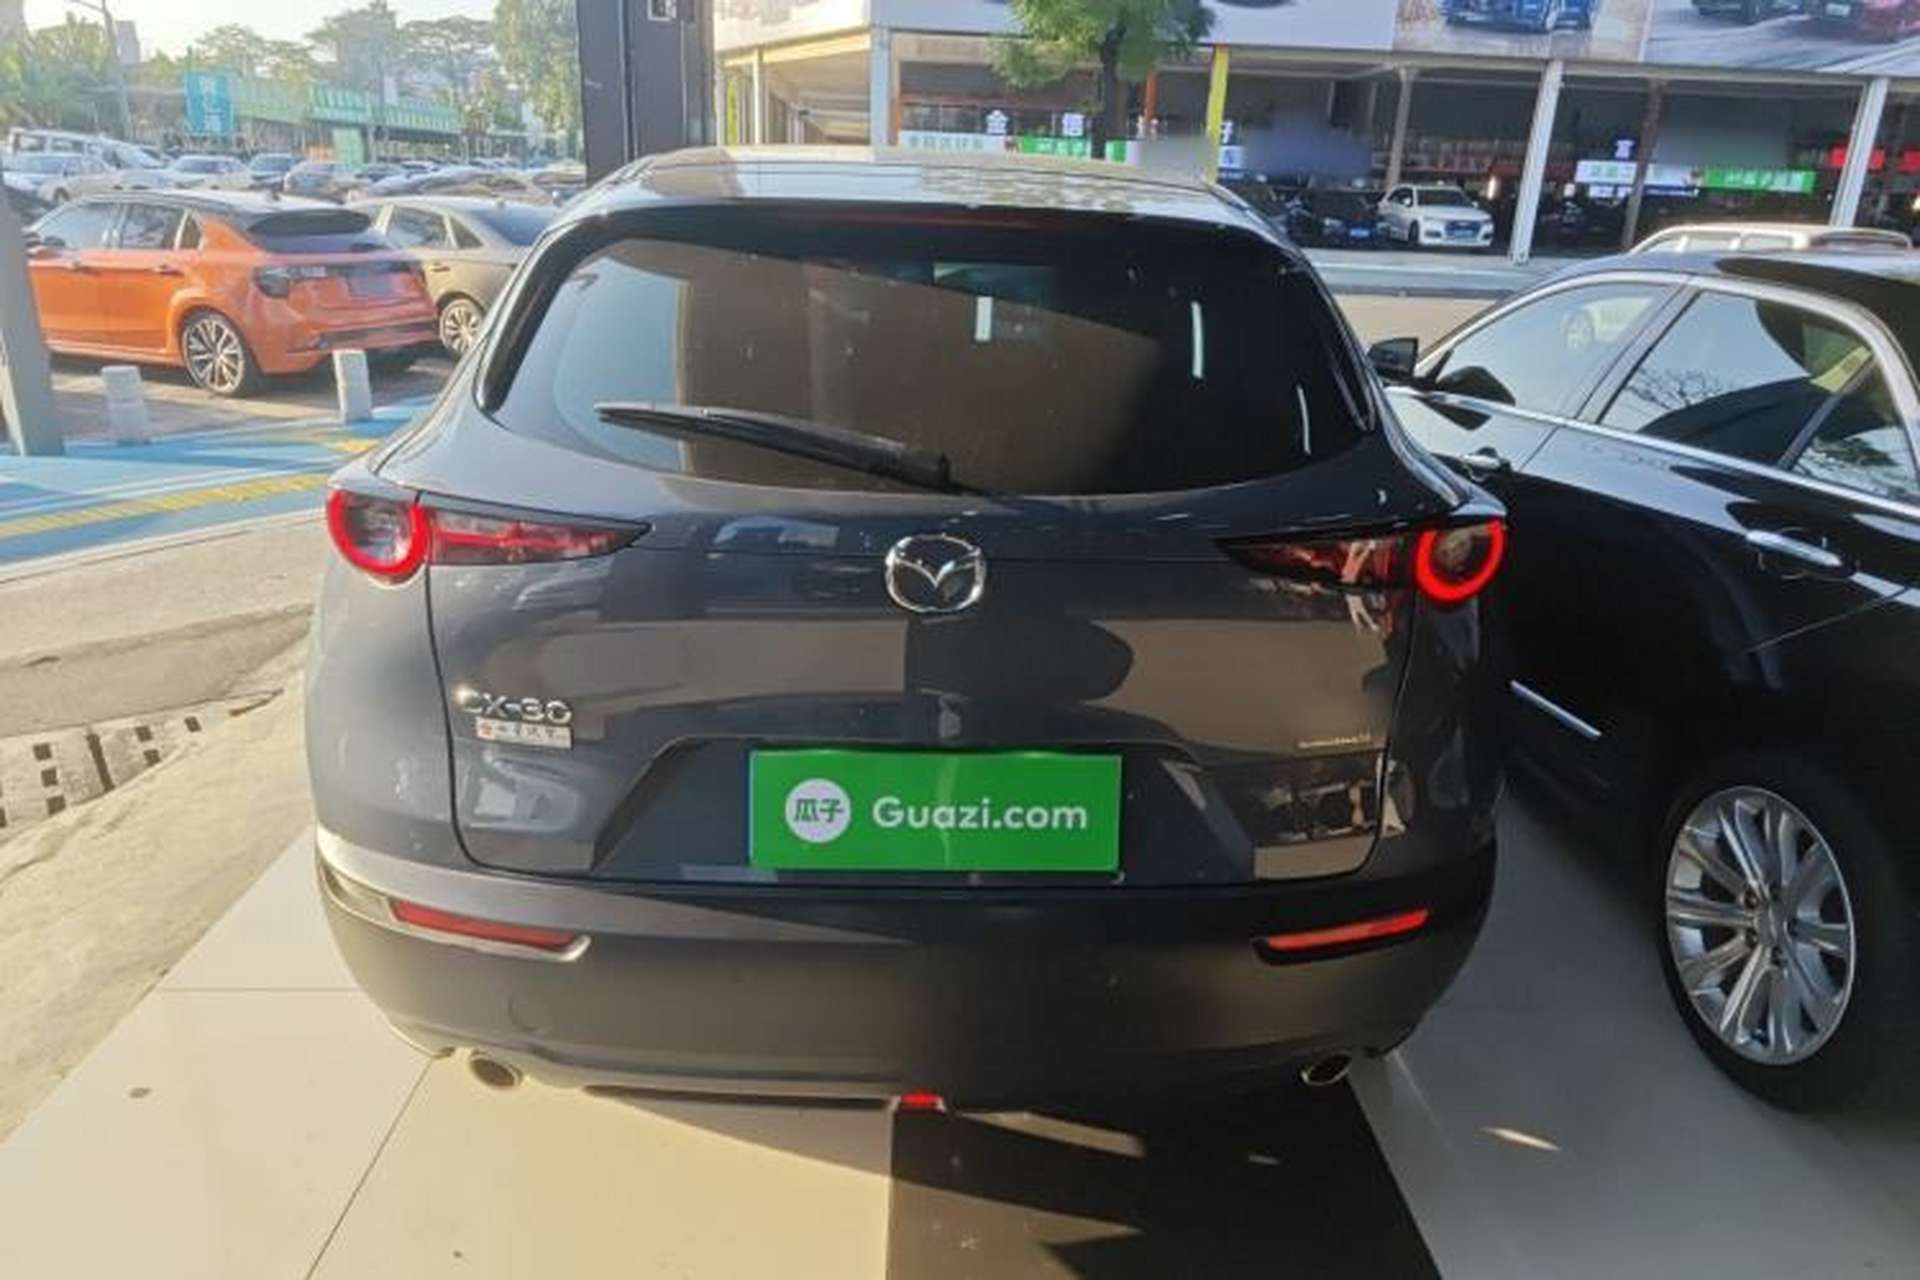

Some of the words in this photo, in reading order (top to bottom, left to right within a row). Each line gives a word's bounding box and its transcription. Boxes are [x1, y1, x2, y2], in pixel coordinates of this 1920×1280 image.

[455, 687, 572, 725] CX-30
[793, 797, 845, 824] 瓜子
[871, 795, 1088, 831] Guazi.com
